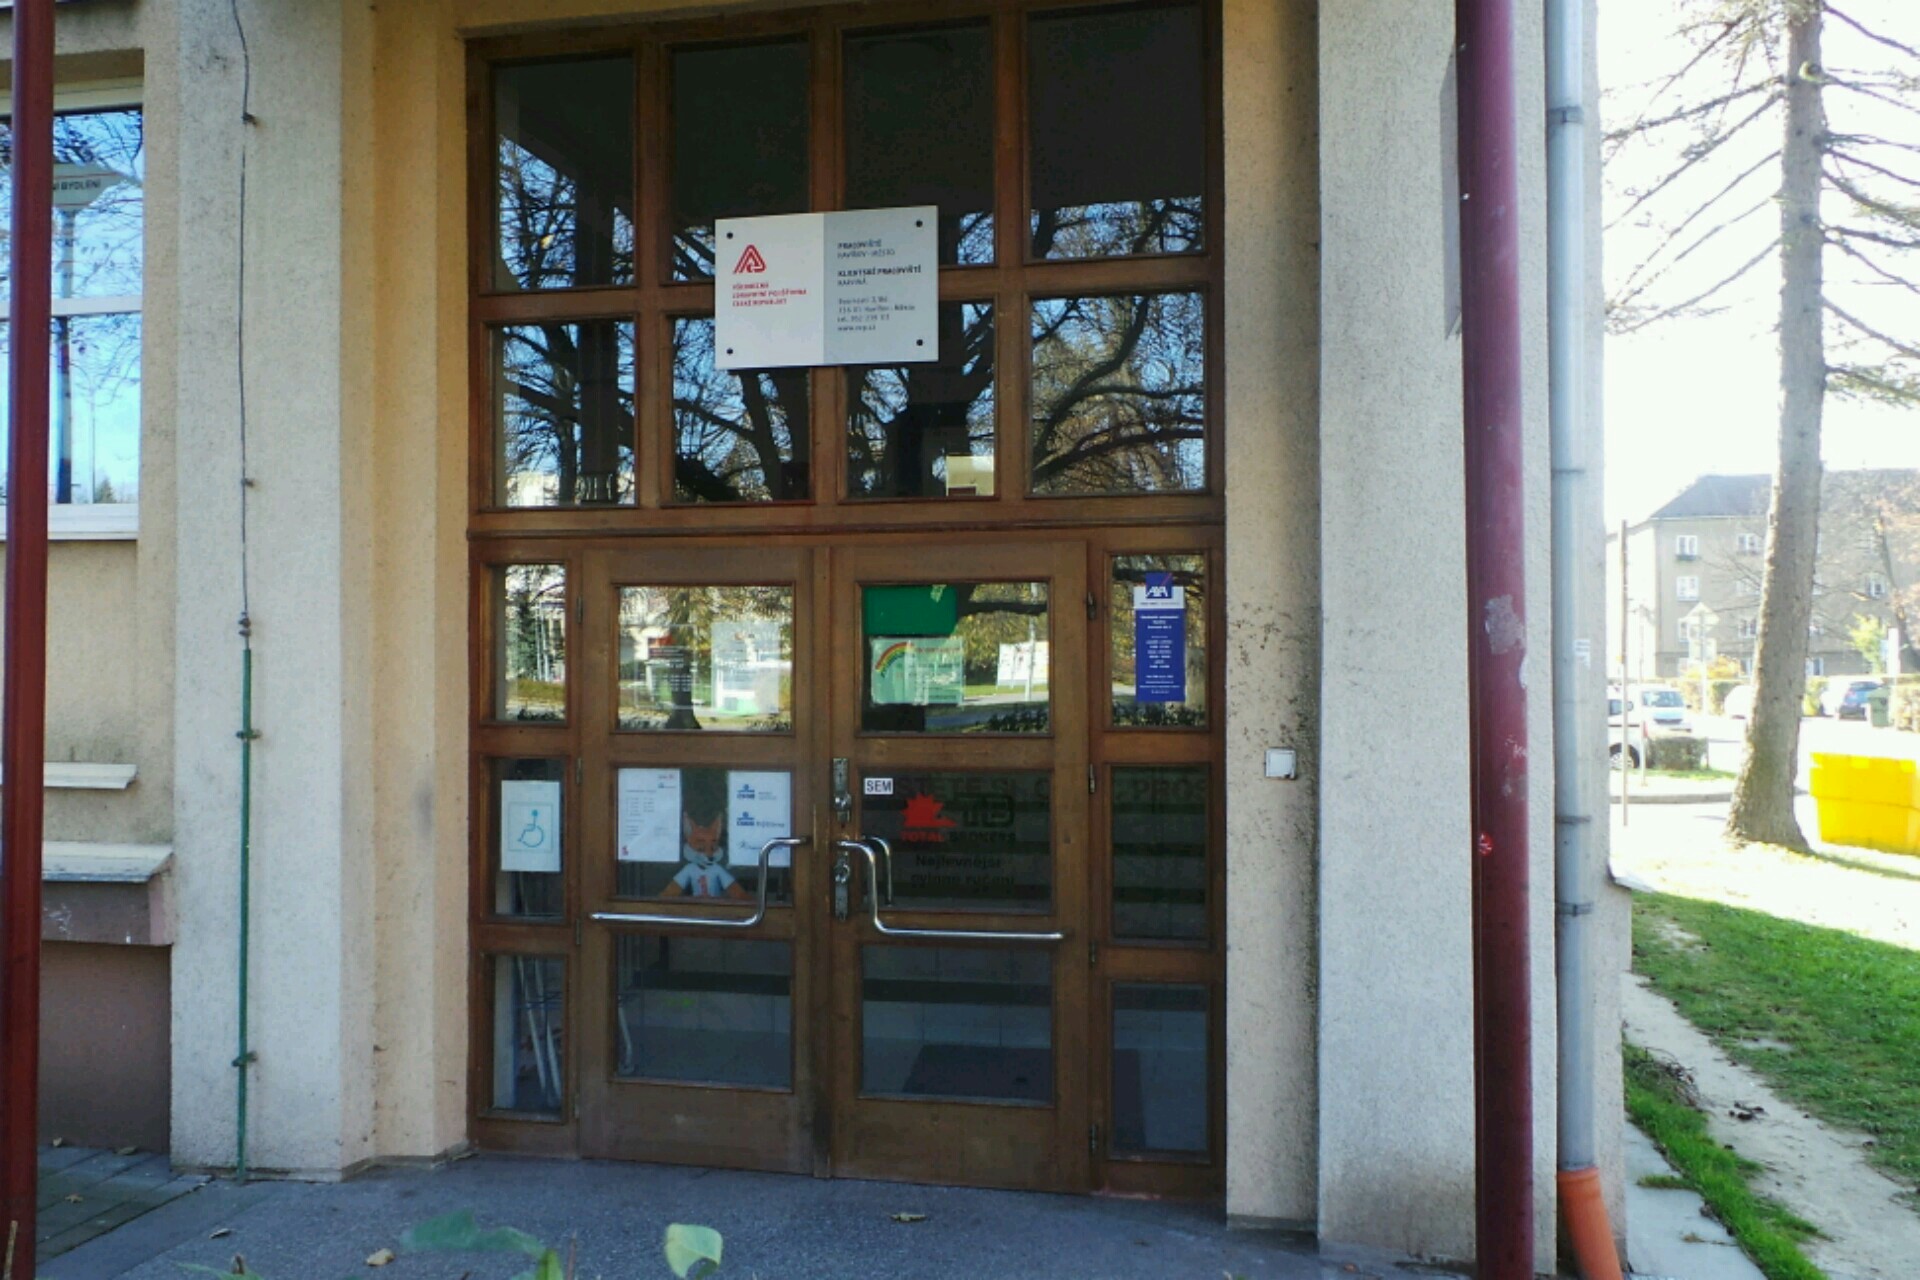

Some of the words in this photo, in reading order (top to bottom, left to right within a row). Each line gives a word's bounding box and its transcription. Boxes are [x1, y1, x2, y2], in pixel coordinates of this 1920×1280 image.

[1146, 586, 1168, 598] AXA
[866, 779, 892, 793] SEM
[900, 831, 945, 842] TOTAL
